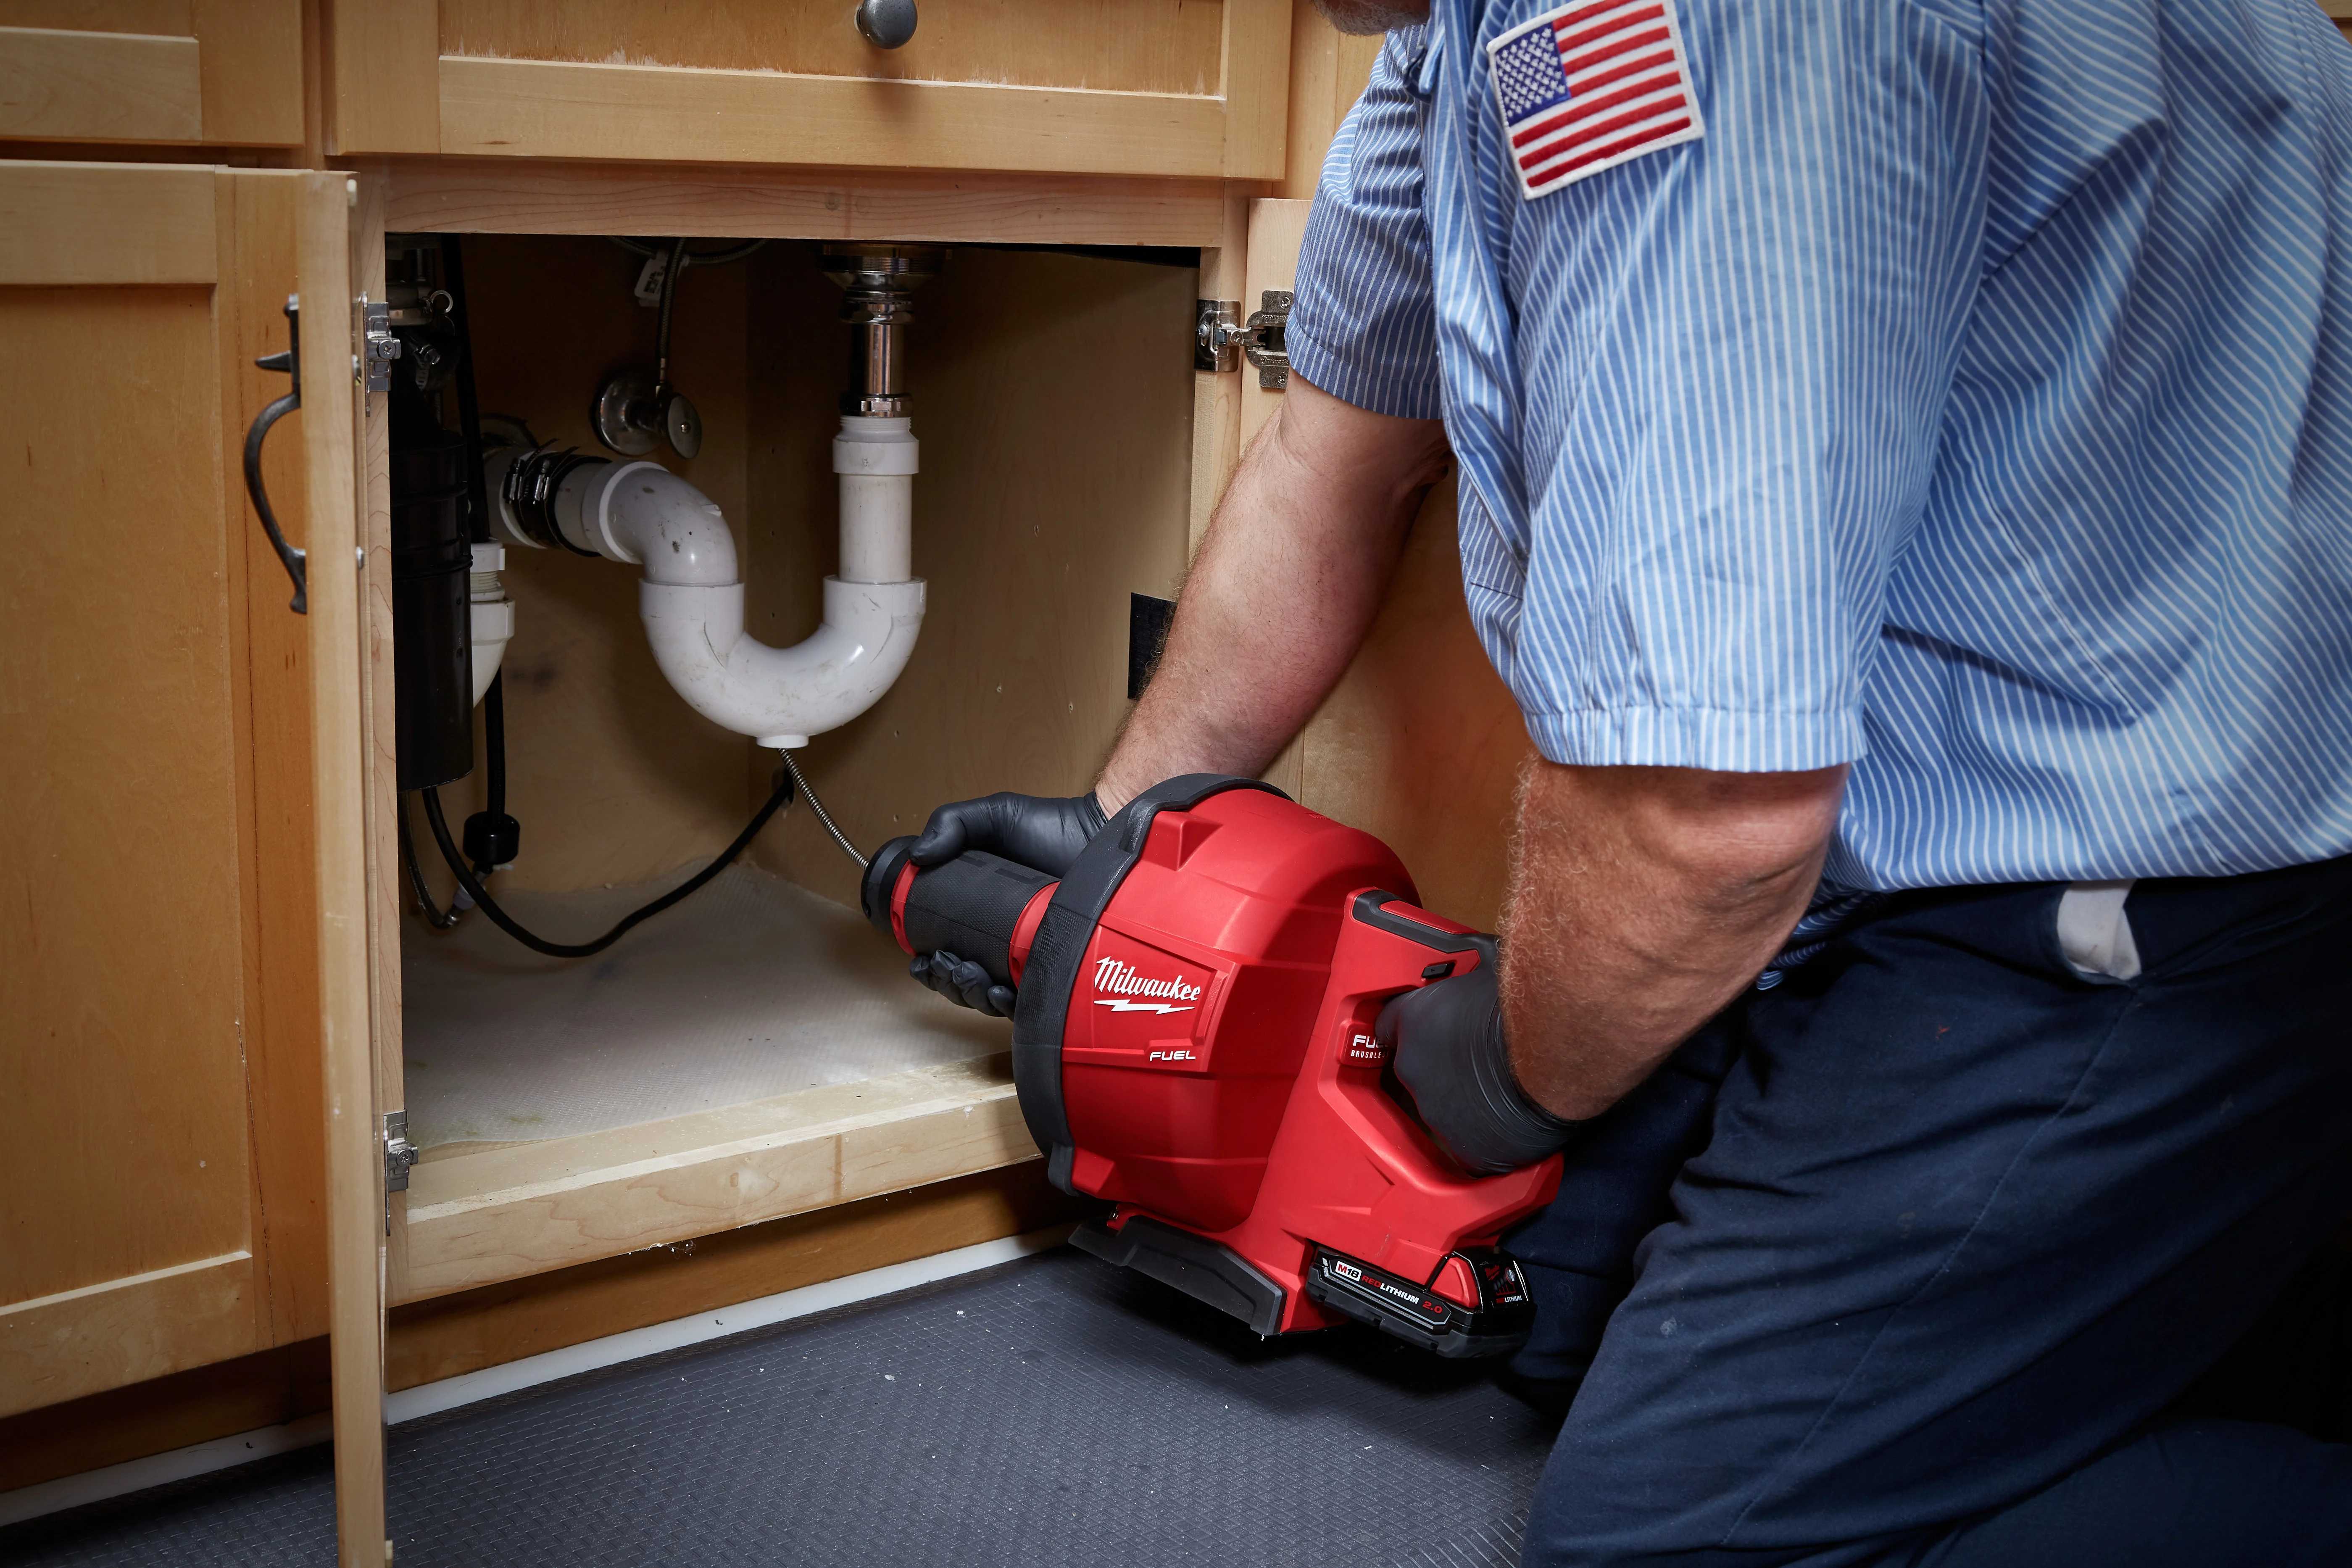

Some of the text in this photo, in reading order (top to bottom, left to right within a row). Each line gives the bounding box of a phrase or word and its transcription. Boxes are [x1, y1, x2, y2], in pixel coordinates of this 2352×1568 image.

[1094, 956, 1201, 1001] Milwaukee
[1149, 1051, 1196, 1061] FUEL
[1337, 1264, 1443, 1314] M18 REDLITHIUM 2.0
